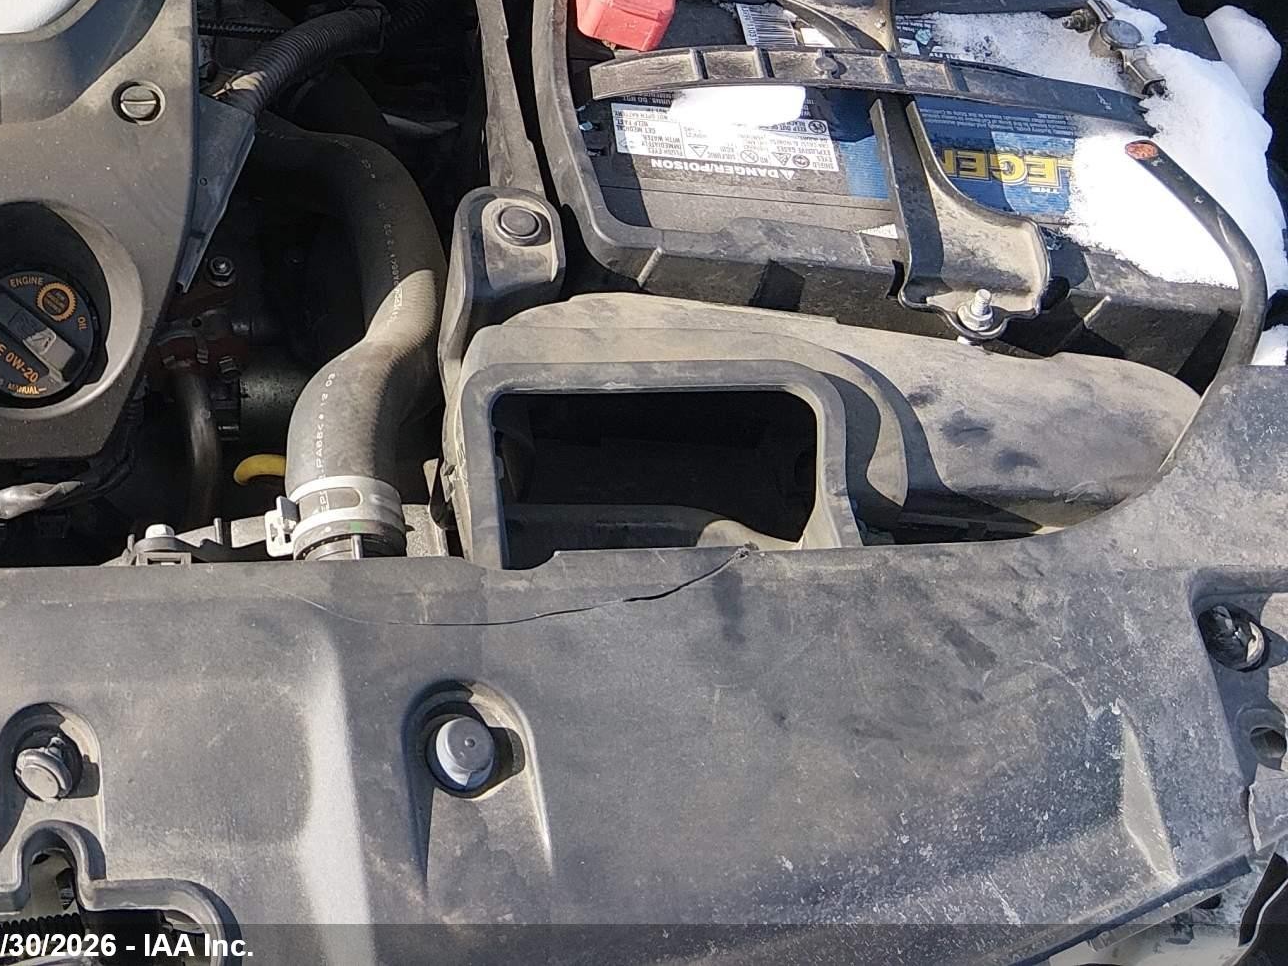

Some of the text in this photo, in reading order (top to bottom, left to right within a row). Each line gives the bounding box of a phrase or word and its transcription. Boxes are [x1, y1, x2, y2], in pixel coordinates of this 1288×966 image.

[664, 135, 680, 143] WITH
[641, 141, 682, 150] IMMEDIATELY
[647, 147, 663, 155] EYES
[651, 159, 779, 178] DANGER/POISON
[8, 276, 45, 288] ENGINE
[77, 316, 88, 331] OIL
[5, 352, 40, 383] 0W-20
